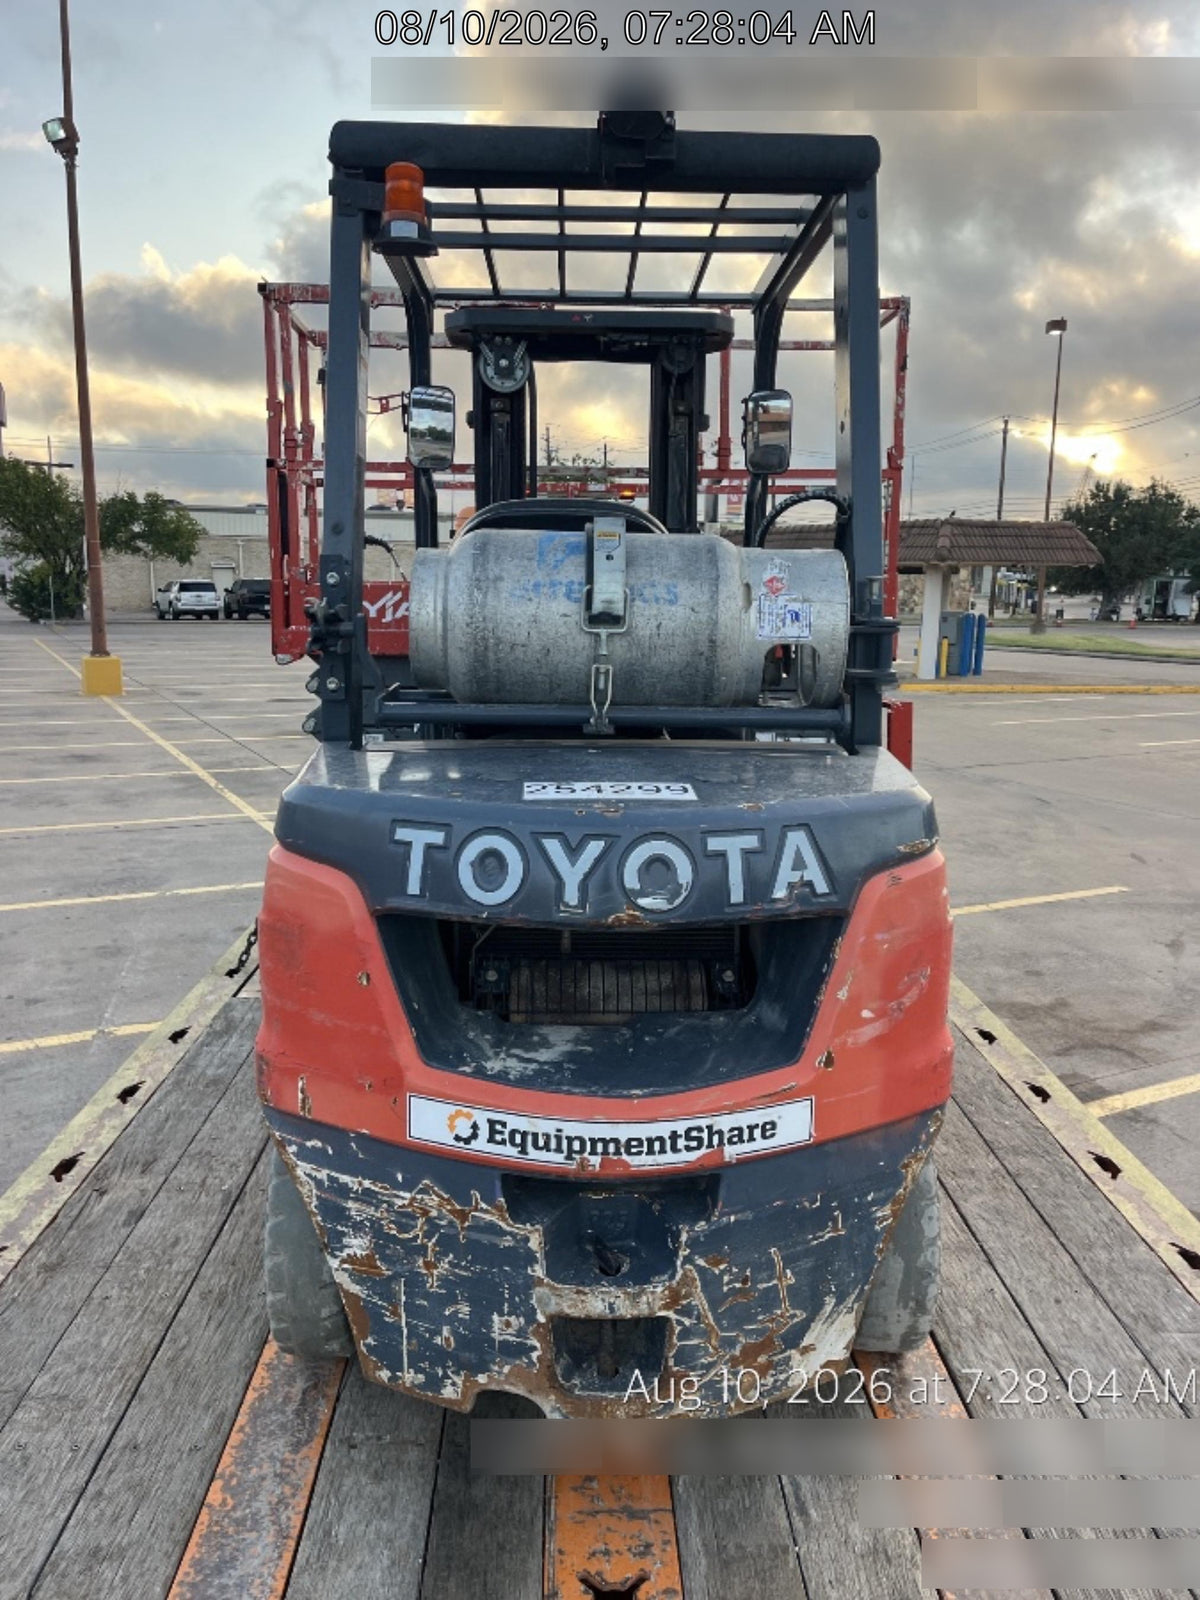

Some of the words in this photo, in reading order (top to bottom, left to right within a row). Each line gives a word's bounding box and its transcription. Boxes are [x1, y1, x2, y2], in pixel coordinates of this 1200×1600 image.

[525, 783, 690, 796] 254299
[392, 822, 834, 914] TOYOTA
[485, 1115, 778, 1161] EquipmentShare
